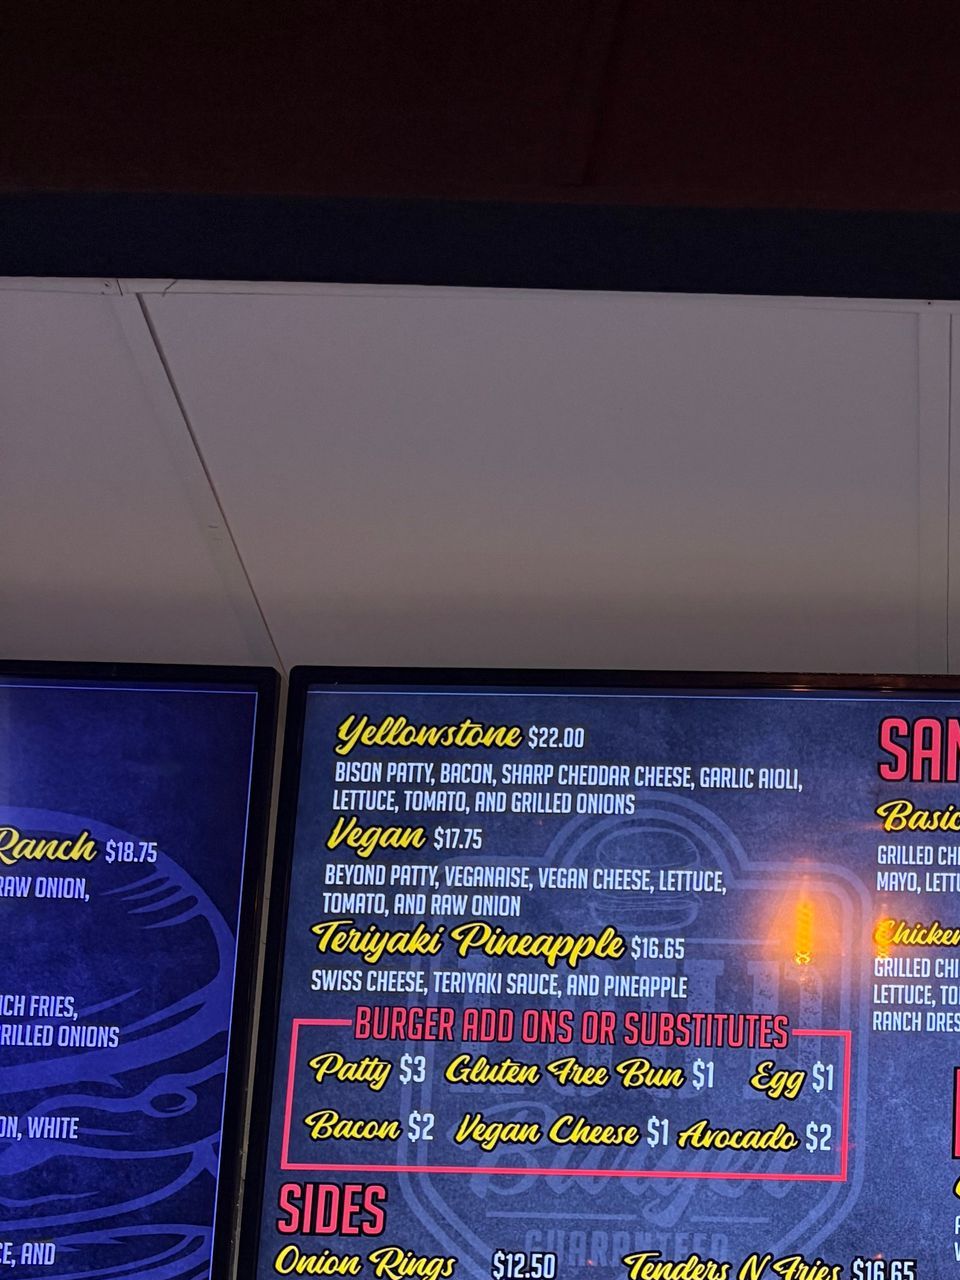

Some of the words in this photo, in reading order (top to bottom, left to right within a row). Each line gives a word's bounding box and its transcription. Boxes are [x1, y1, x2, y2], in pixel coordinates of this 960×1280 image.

[335, 715, 520, 755] Yellowstone
[528, 725, 585, 750] $22.00
[335, 761, 382, 783] BISON
[386, 762, 436, 786] PATTY,
[440, 762, 497, 787] BACON,
[501, 763, 554, 785] SHARP
[558, 764, 630, 786] CHEDDAR
[634, 766, 695, 791] CHEESE,
[700, 767, 754, 789] GARLIC
[758, 768, 803, 793] AIOLI,
[332, 789, 399, 814] LETTUCE,
[404, 790, 470, 815] TOMATO,
[474, 791, 507, 812] AND
[511, 792, 572, 814] GRILLED
[576, 793, 636, 815] ONIONS
[105, 838, 158, 864] $18.75
[327, 817, 426, 858] Vegan
[433, 826, 482, 851] $17.75
[877, 845, 934, 865] GRILLED
[34, 876, 90, 902] ONION,
[311, 920, 444, 964] Teriyaki
[450, 922, 624, 968] Pineapple
[630, 934, 685, 960] $16.65
[311, 969, 363, 991] SWISS
[366, 970, 428, 996] CHEESE,
[433, 971, 502, 994] TERIYAKI
[506, 972, 562, 999] SAUCE,
[566, 974, 600, 996] AND
[604, 975, 688, 998] PINEAPPLE
[0, 994, 26, 1016] CH
[29, 995, 78, 1021] FRIES,
[872, 1010, 922, 1032] RANCH
[0, 1024, 54, 1046] RILLED
[57, 1025, 120, 1048] ONIONS
[355, 1006, 454, 1040] BURGER
[462, 1008, 514, 1042] ADD
[522, 1010, 573, 1043] ONS
[582, 1011, 616, 1044] OR
[624, 1012, 788, 1048] SUBSTITUTES
[27, 1116, 80, 1139] WHITE
[304, 1110, 399, 1140] Bacon
[407, 1110, 435, 1143] $2
[455, 1114, 539, 1150] Vegan
[549, 1115, 638, 1145] Cheese
[646, 1115, 669, 1148] $1
[678, 1120, 797, 1150] Avocado
[805, 1120, 832, 1154] $2
[278, 1183, 386, 1234] SIDES
[20, 1242, 56, 1265] AND
[274, 1245, 360, 1275] Onion
[492, 1250, 556, 1280] $12.50
